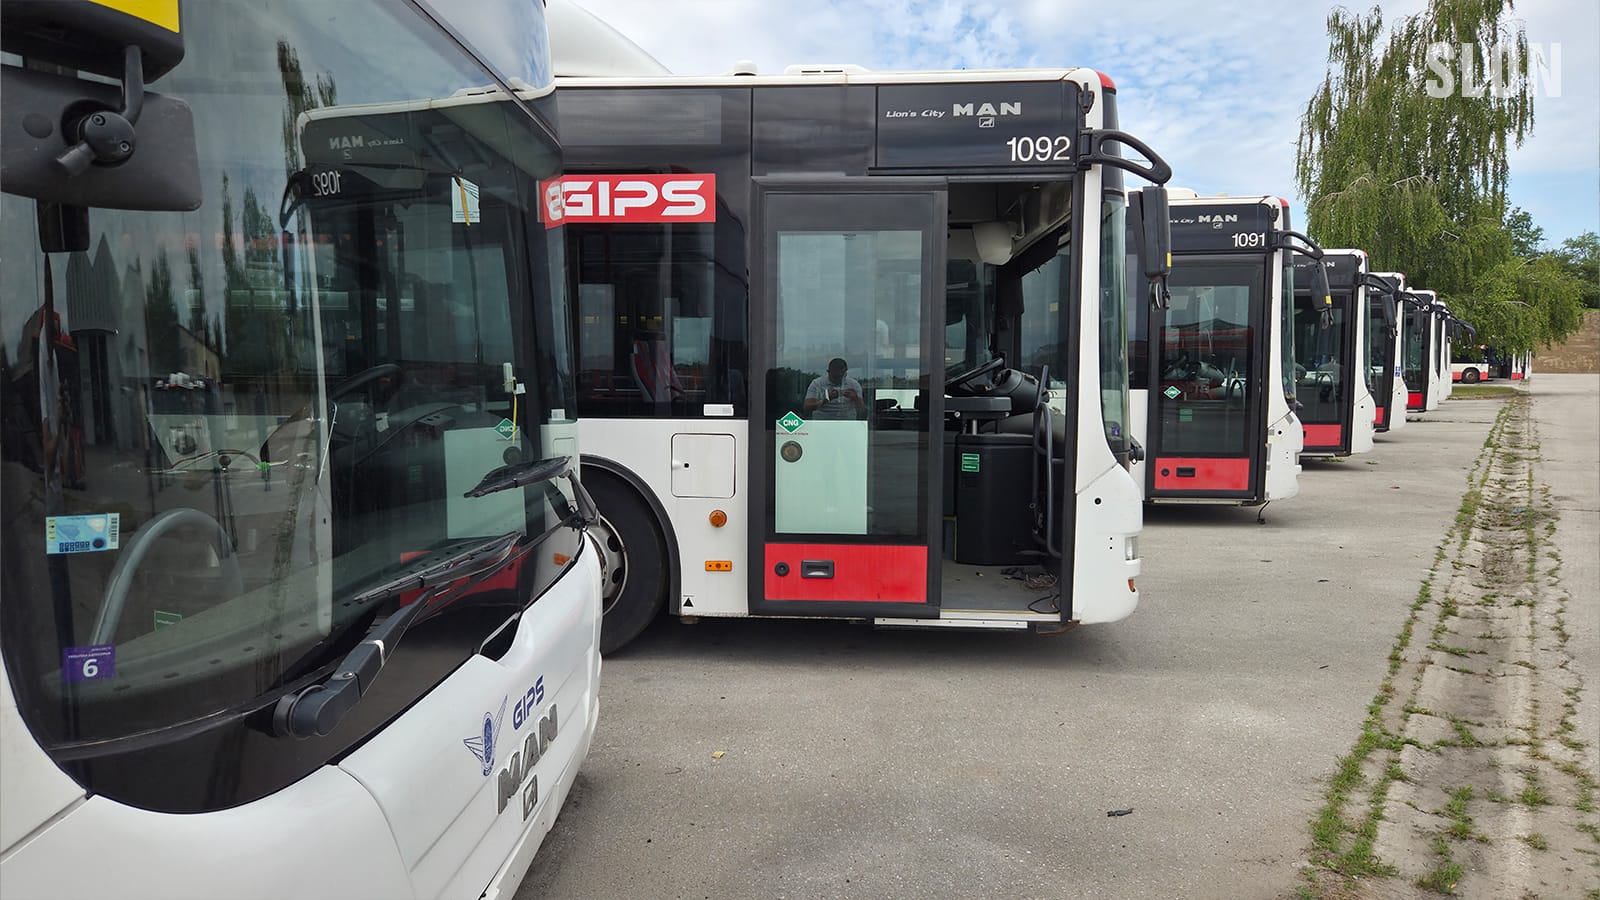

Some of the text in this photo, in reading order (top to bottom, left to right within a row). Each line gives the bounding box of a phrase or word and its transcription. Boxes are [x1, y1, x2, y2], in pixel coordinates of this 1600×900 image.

[886, 102, 1021, 118] Lion's City MAN
[1006, 136, 1071, 162] 1092
[561, 180, 706, 217] GIPS
[1198, 214, 1239, 223] MAN
[1231, 232, 1266, 248] 1091
[82, 658, 99, 678] 6
[512, 674, 545, 730] GIPS
[497, 703, 559, 815] MAN
